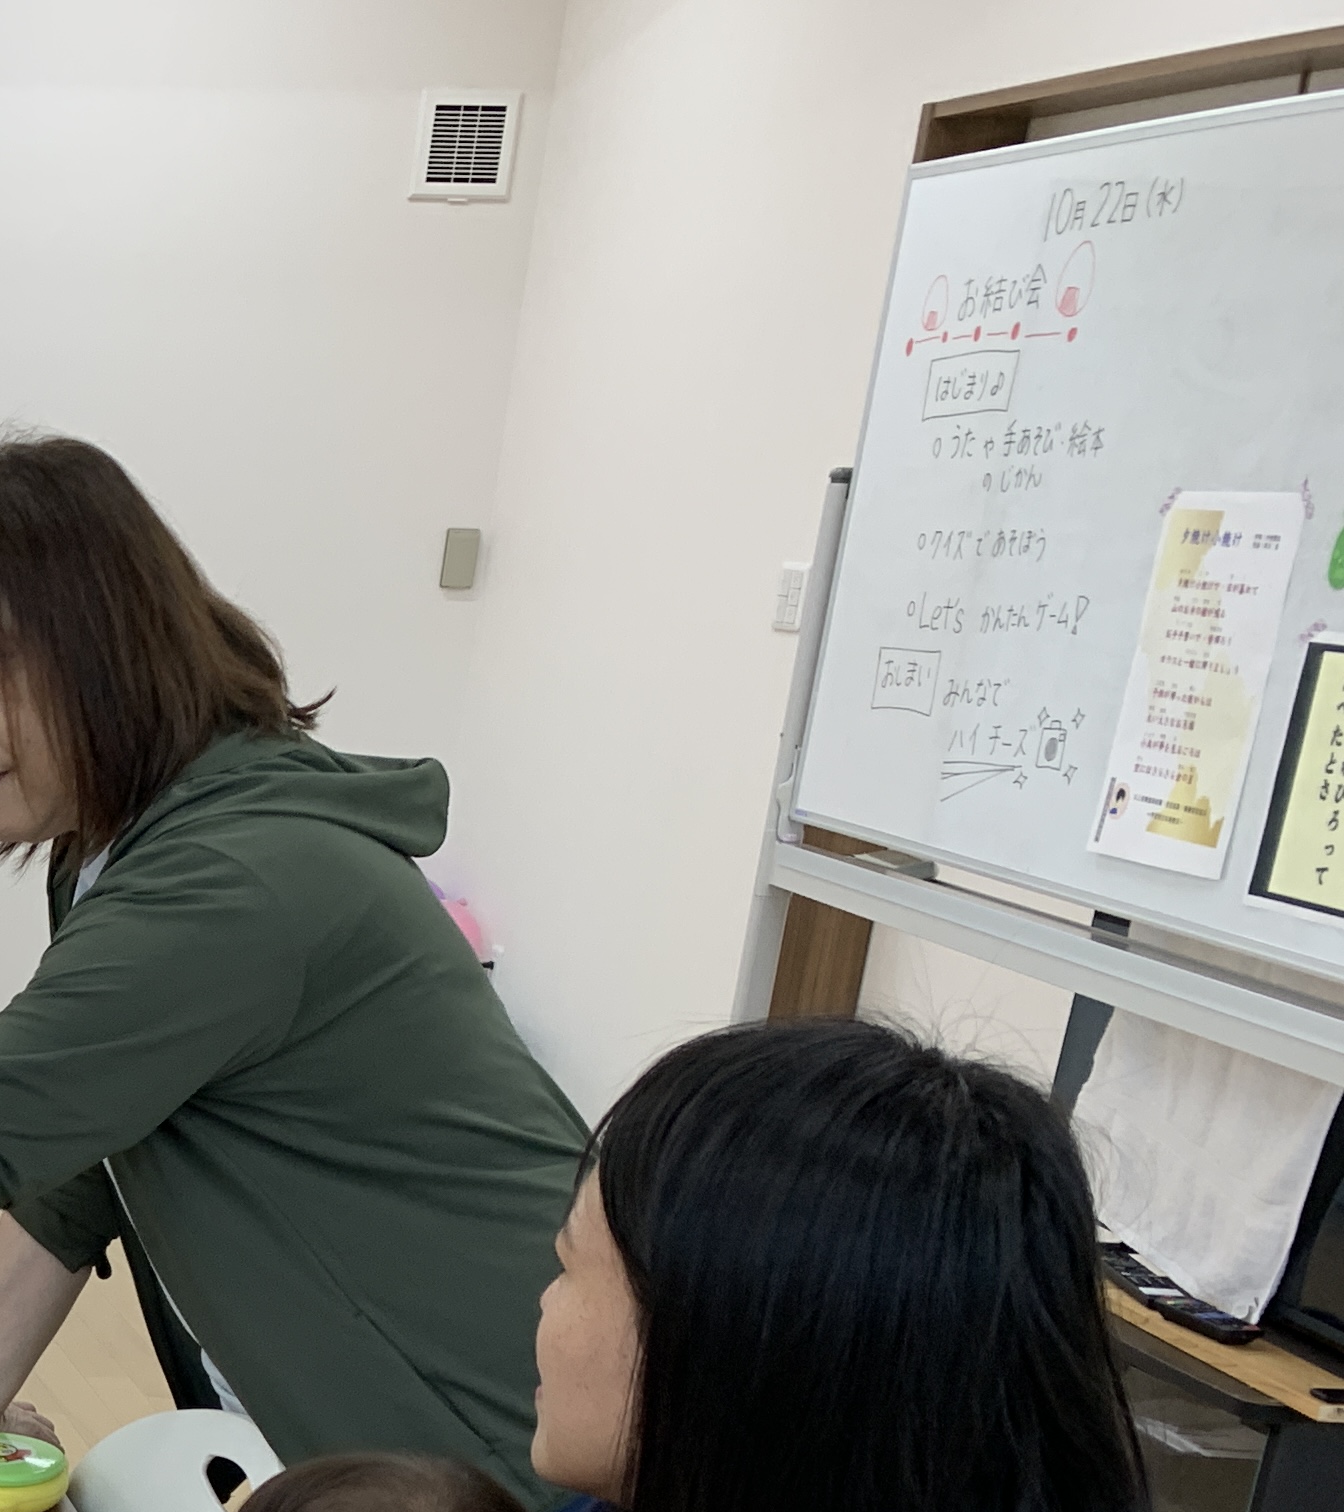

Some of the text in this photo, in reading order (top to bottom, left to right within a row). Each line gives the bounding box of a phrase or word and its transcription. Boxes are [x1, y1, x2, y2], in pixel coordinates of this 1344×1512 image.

[957, 264, 1048, 321] お結び会
[982, 464, 1043, 493] のじかん
[919, 592, 965, 634] Let's
[880, 660, 932, 688] おしまい
[942, 678, 1011, 708] みんなで
